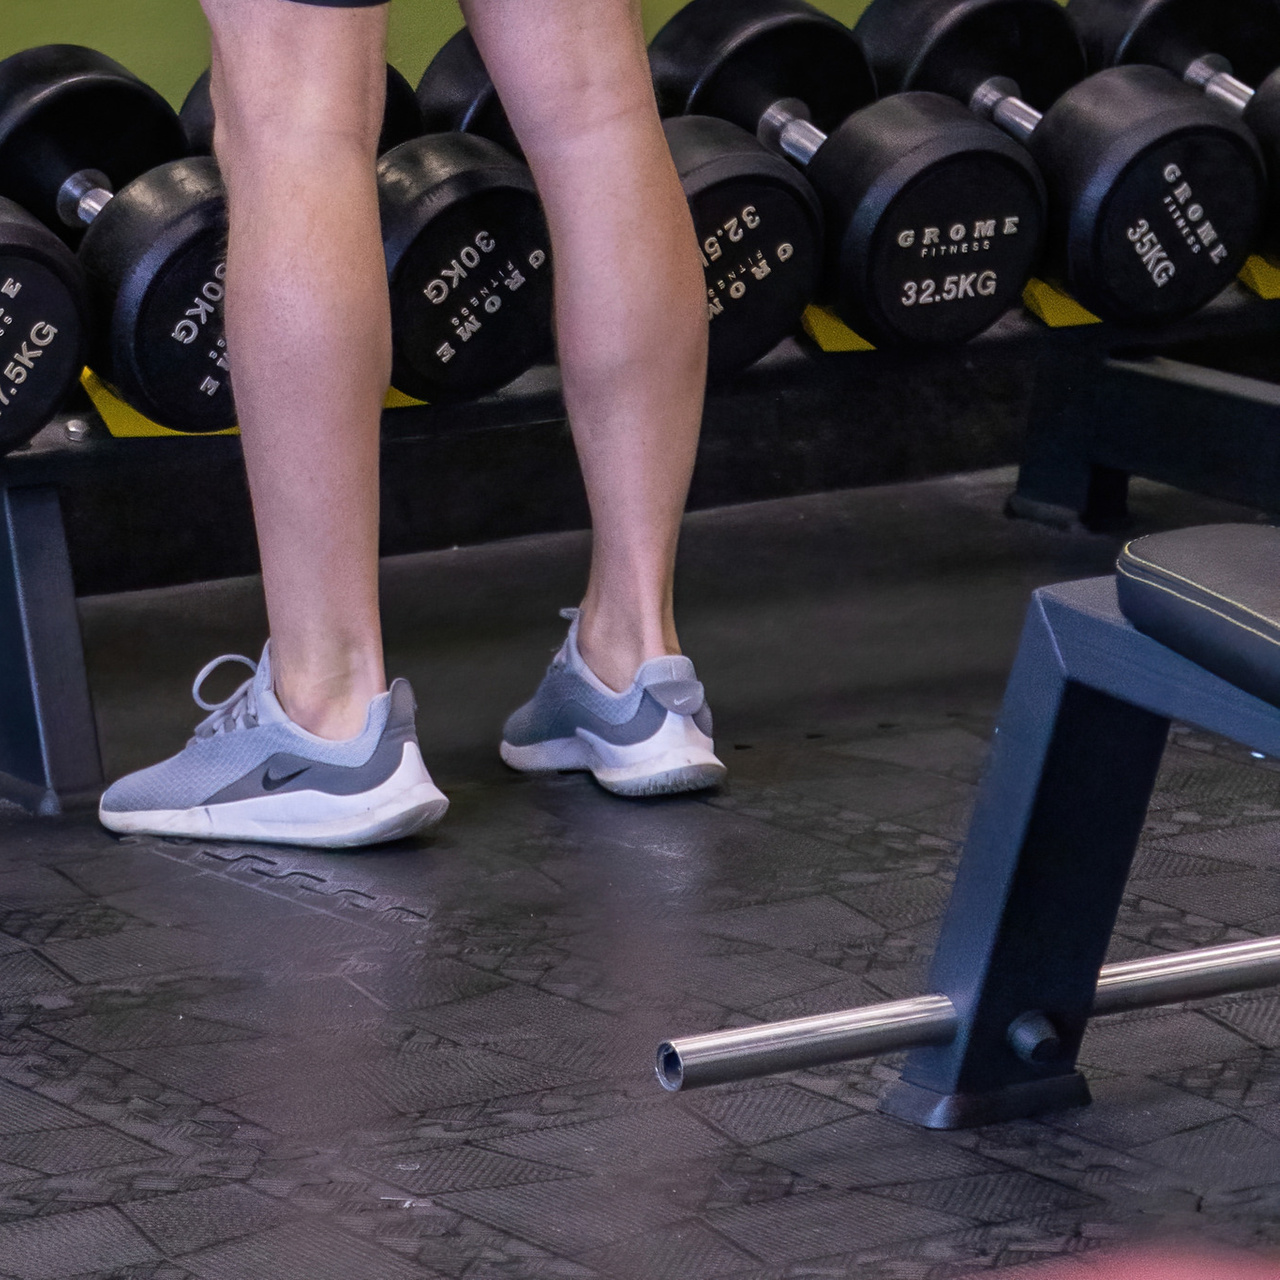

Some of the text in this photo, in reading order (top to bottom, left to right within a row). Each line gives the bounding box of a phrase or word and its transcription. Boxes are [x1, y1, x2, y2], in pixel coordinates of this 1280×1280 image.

[897, 216, 1020, 248] GROME
[1163, 163, 1228, 265] GROME
[1163, 195, 1201, 254] FITNESS
[423, 230, 496, 305] 30KG
[707, 249, 763, 298] FITNES
[708, 242, 794, 321] GROM
[921, 240, 991, 258] FITNESS
[1127, 218, 1176, 288] 35KG
[436, 249, 546, 364] GROME
[451, 260, 515, 327] FITNESS
[901, 270, 998, 307] 32.5KG
